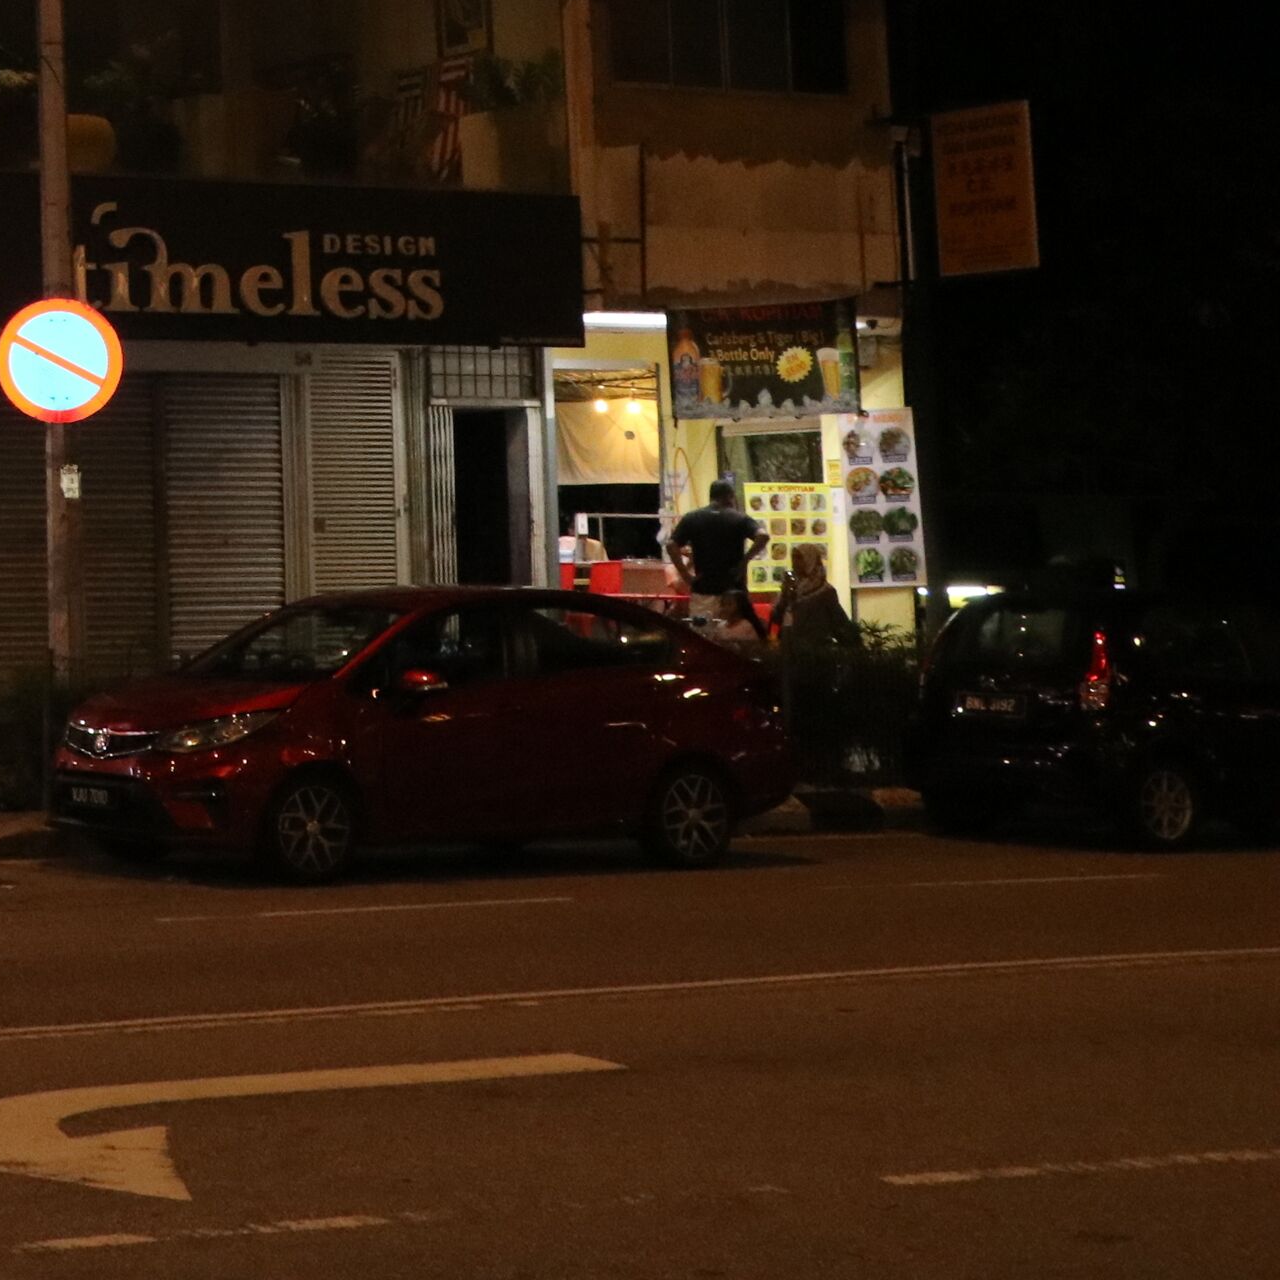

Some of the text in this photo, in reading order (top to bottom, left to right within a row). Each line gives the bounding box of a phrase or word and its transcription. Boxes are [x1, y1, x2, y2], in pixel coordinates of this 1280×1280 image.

[320, 231, 437, 257] DESIGN
[705, 330, 756, 348] Carlsberg
[717, 349, 749, 362] Bottle
[750, 347, 775, 362] Only
